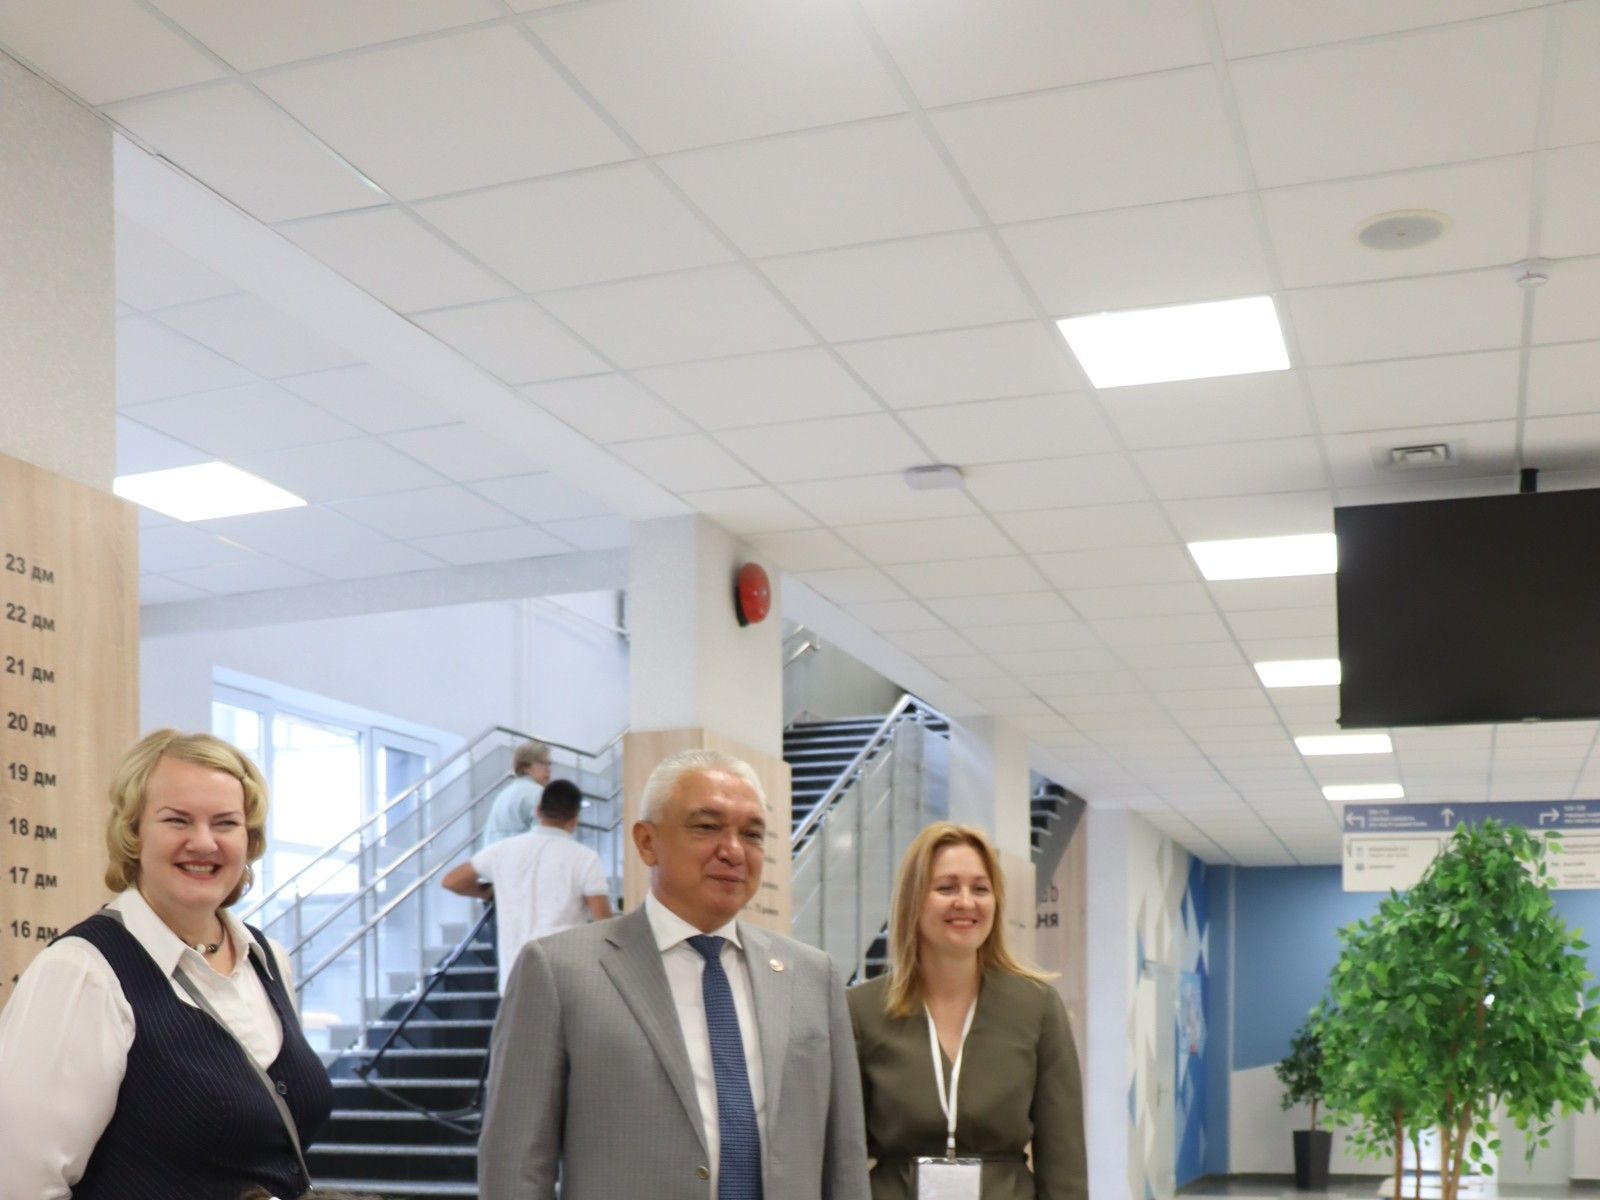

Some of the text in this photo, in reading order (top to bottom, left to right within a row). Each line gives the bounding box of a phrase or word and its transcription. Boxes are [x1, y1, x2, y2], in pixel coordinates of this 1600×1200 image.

[5, 553, 54, 584] 23 дм
[6, 602, 55, 632] 22 дм
[6, 656, 55, 683] 21 дм
[7, 712, 56, 738] 20 дм
[8, 762, 57, 787] 19 дм
[9, 817, 57, 841] 18 дм
[9, 866, 57, 889] 17 дм
[10, 920, 59, 942] 16 дм
